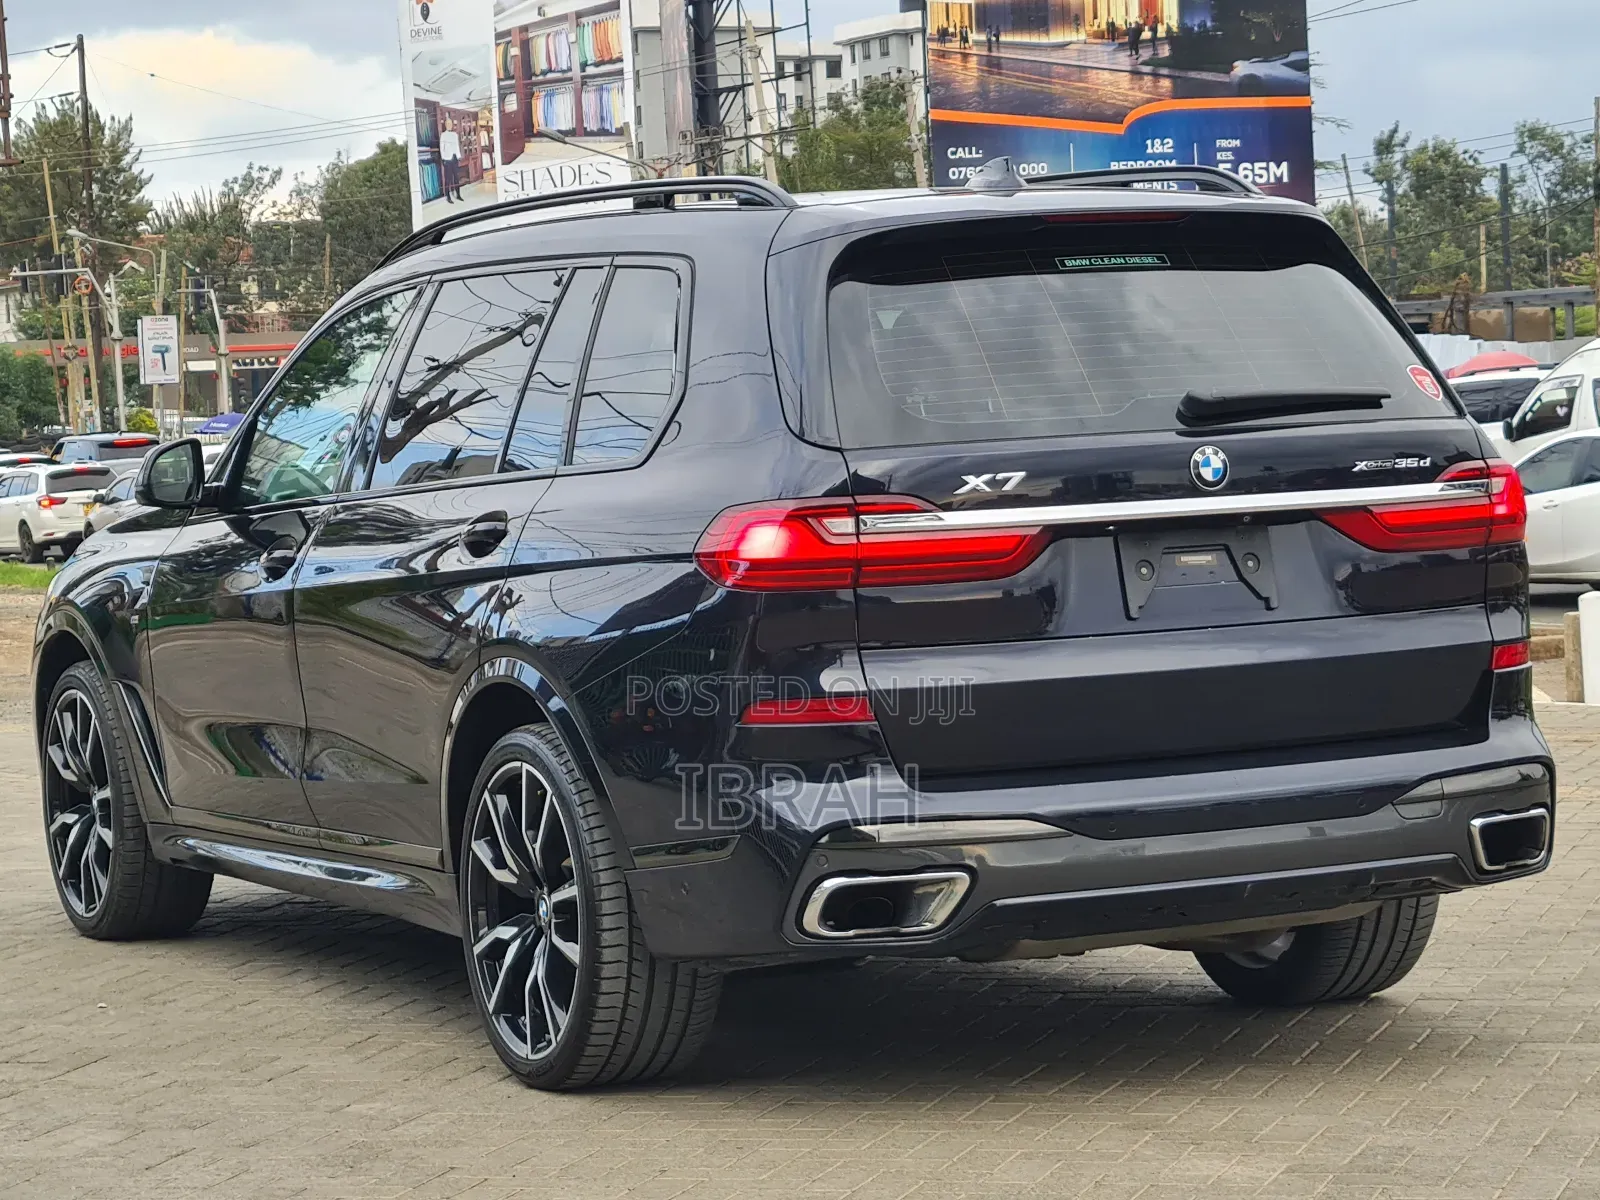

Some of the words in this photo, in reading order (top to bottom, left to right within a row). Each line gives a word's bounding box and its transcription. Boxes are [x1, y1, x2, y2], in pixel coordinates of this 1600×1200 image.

[410, 26, 442, 38] DEVINE
[1145, 138, 1174, 153] 1&2
[1216, 139, 1241, 148] FROM
[947, 146, 983, 159] CALL:
[503, 161, 612, 193] SHADES
[1064, 259, 1090, 267] BMW
[1090, 257, 1124, 266] CLEAN
[1125, 256, 1162, 264] DIESEL
[1194, 447, 1226, 461] BMW
[952, 471, 1027, 495] X7
